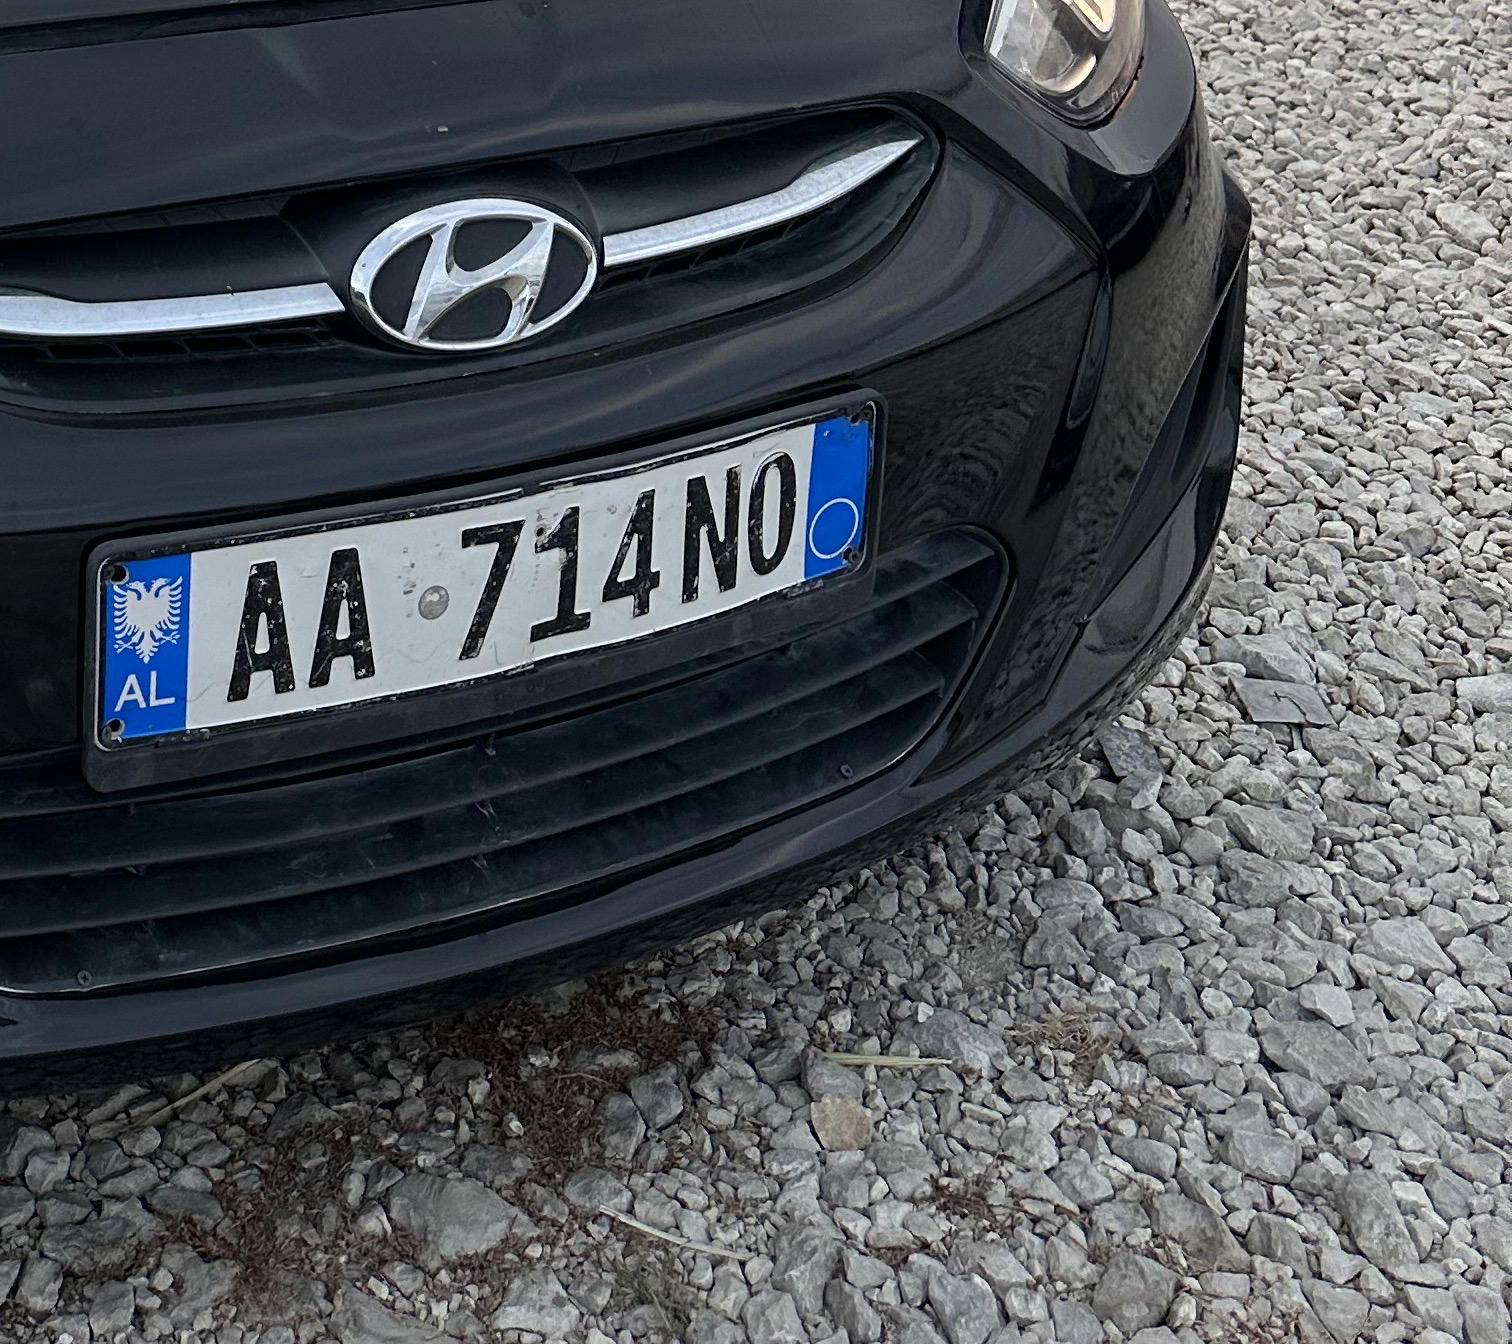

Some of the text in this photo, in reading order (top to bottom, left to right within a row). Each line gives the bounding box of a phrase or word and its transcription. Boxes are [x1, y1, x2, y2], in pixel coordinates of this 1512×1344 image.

[226, 451, 797, 703] AA 714NO
[114, 670, 176, 712] AL
